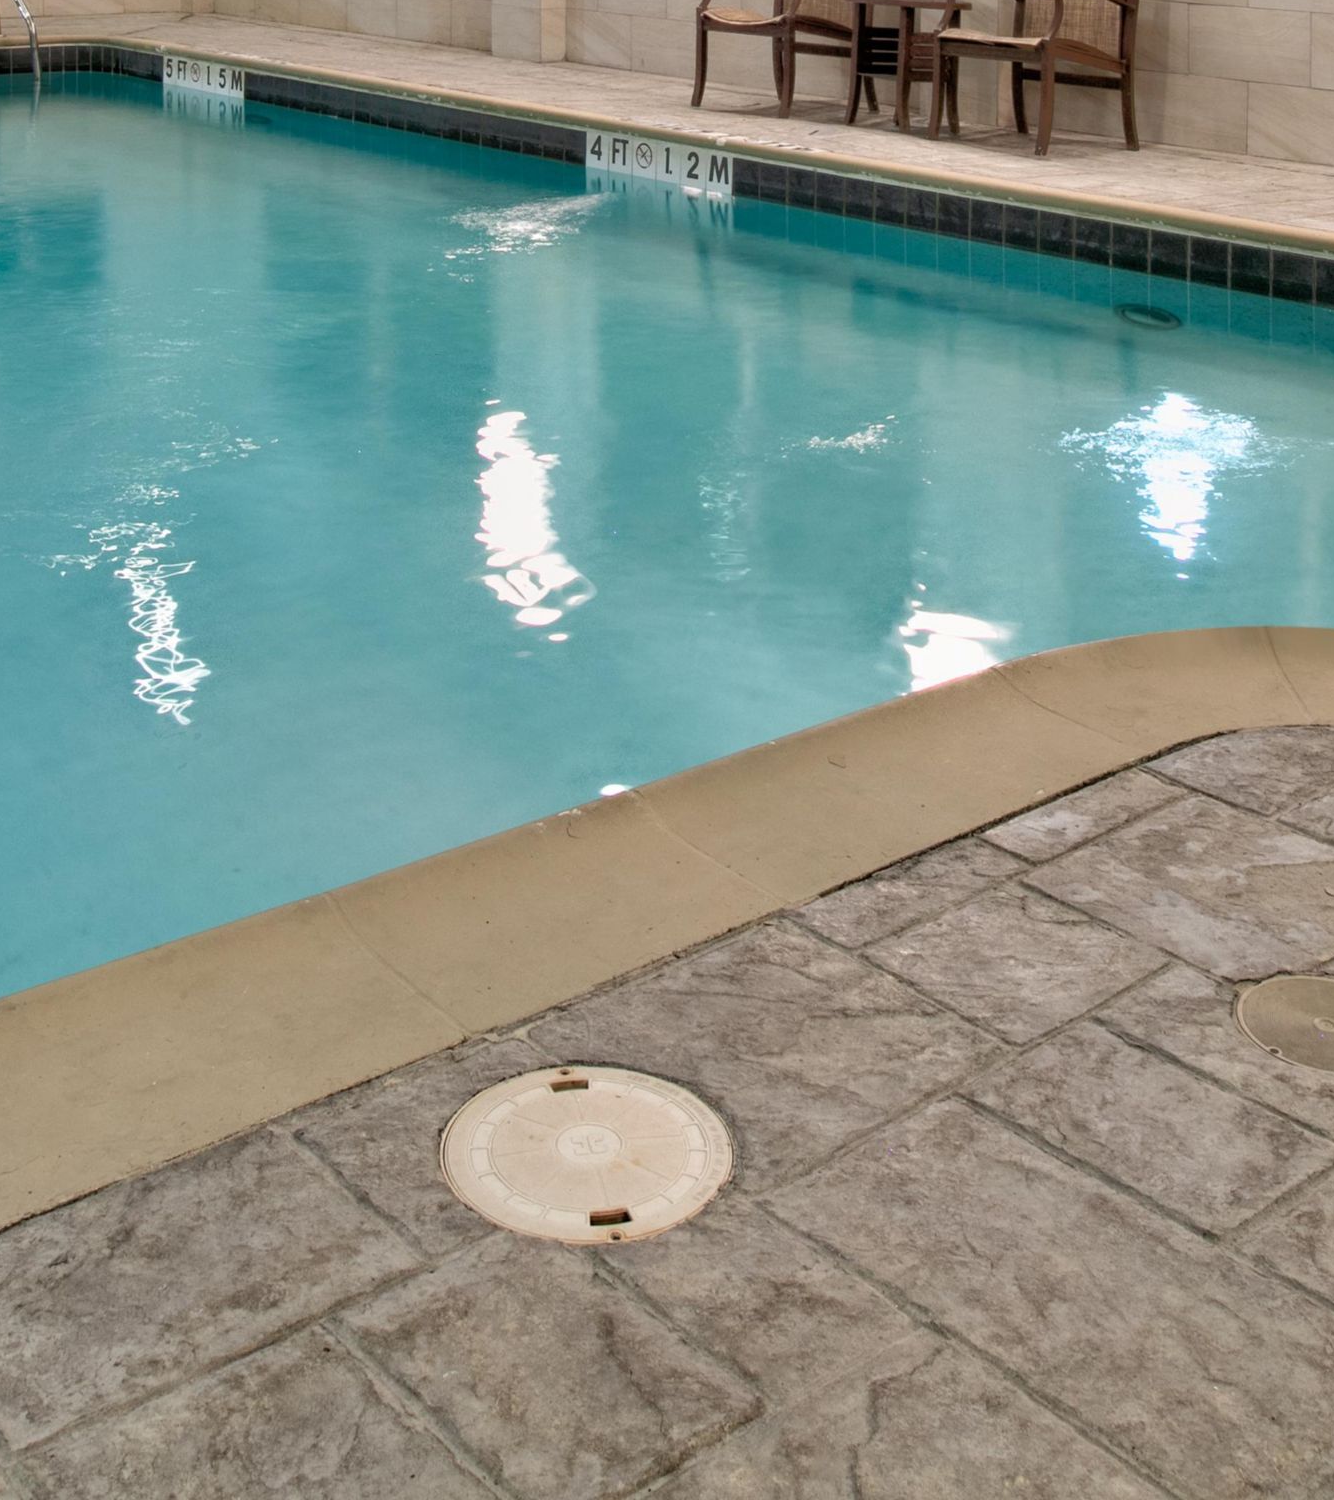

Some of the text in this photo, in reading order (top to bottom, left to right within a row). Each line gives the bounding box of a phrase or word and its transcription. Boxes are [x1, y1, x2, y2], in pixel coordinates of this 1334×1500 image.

[166, 58, 174, 78] 5
[177, 60, 187, 80] FT
[231, 70, 243, 92] M
[590, 135, 602, 161] 4
[612, 138, 629, 166] FT
[709, 155, 729, 185] M
